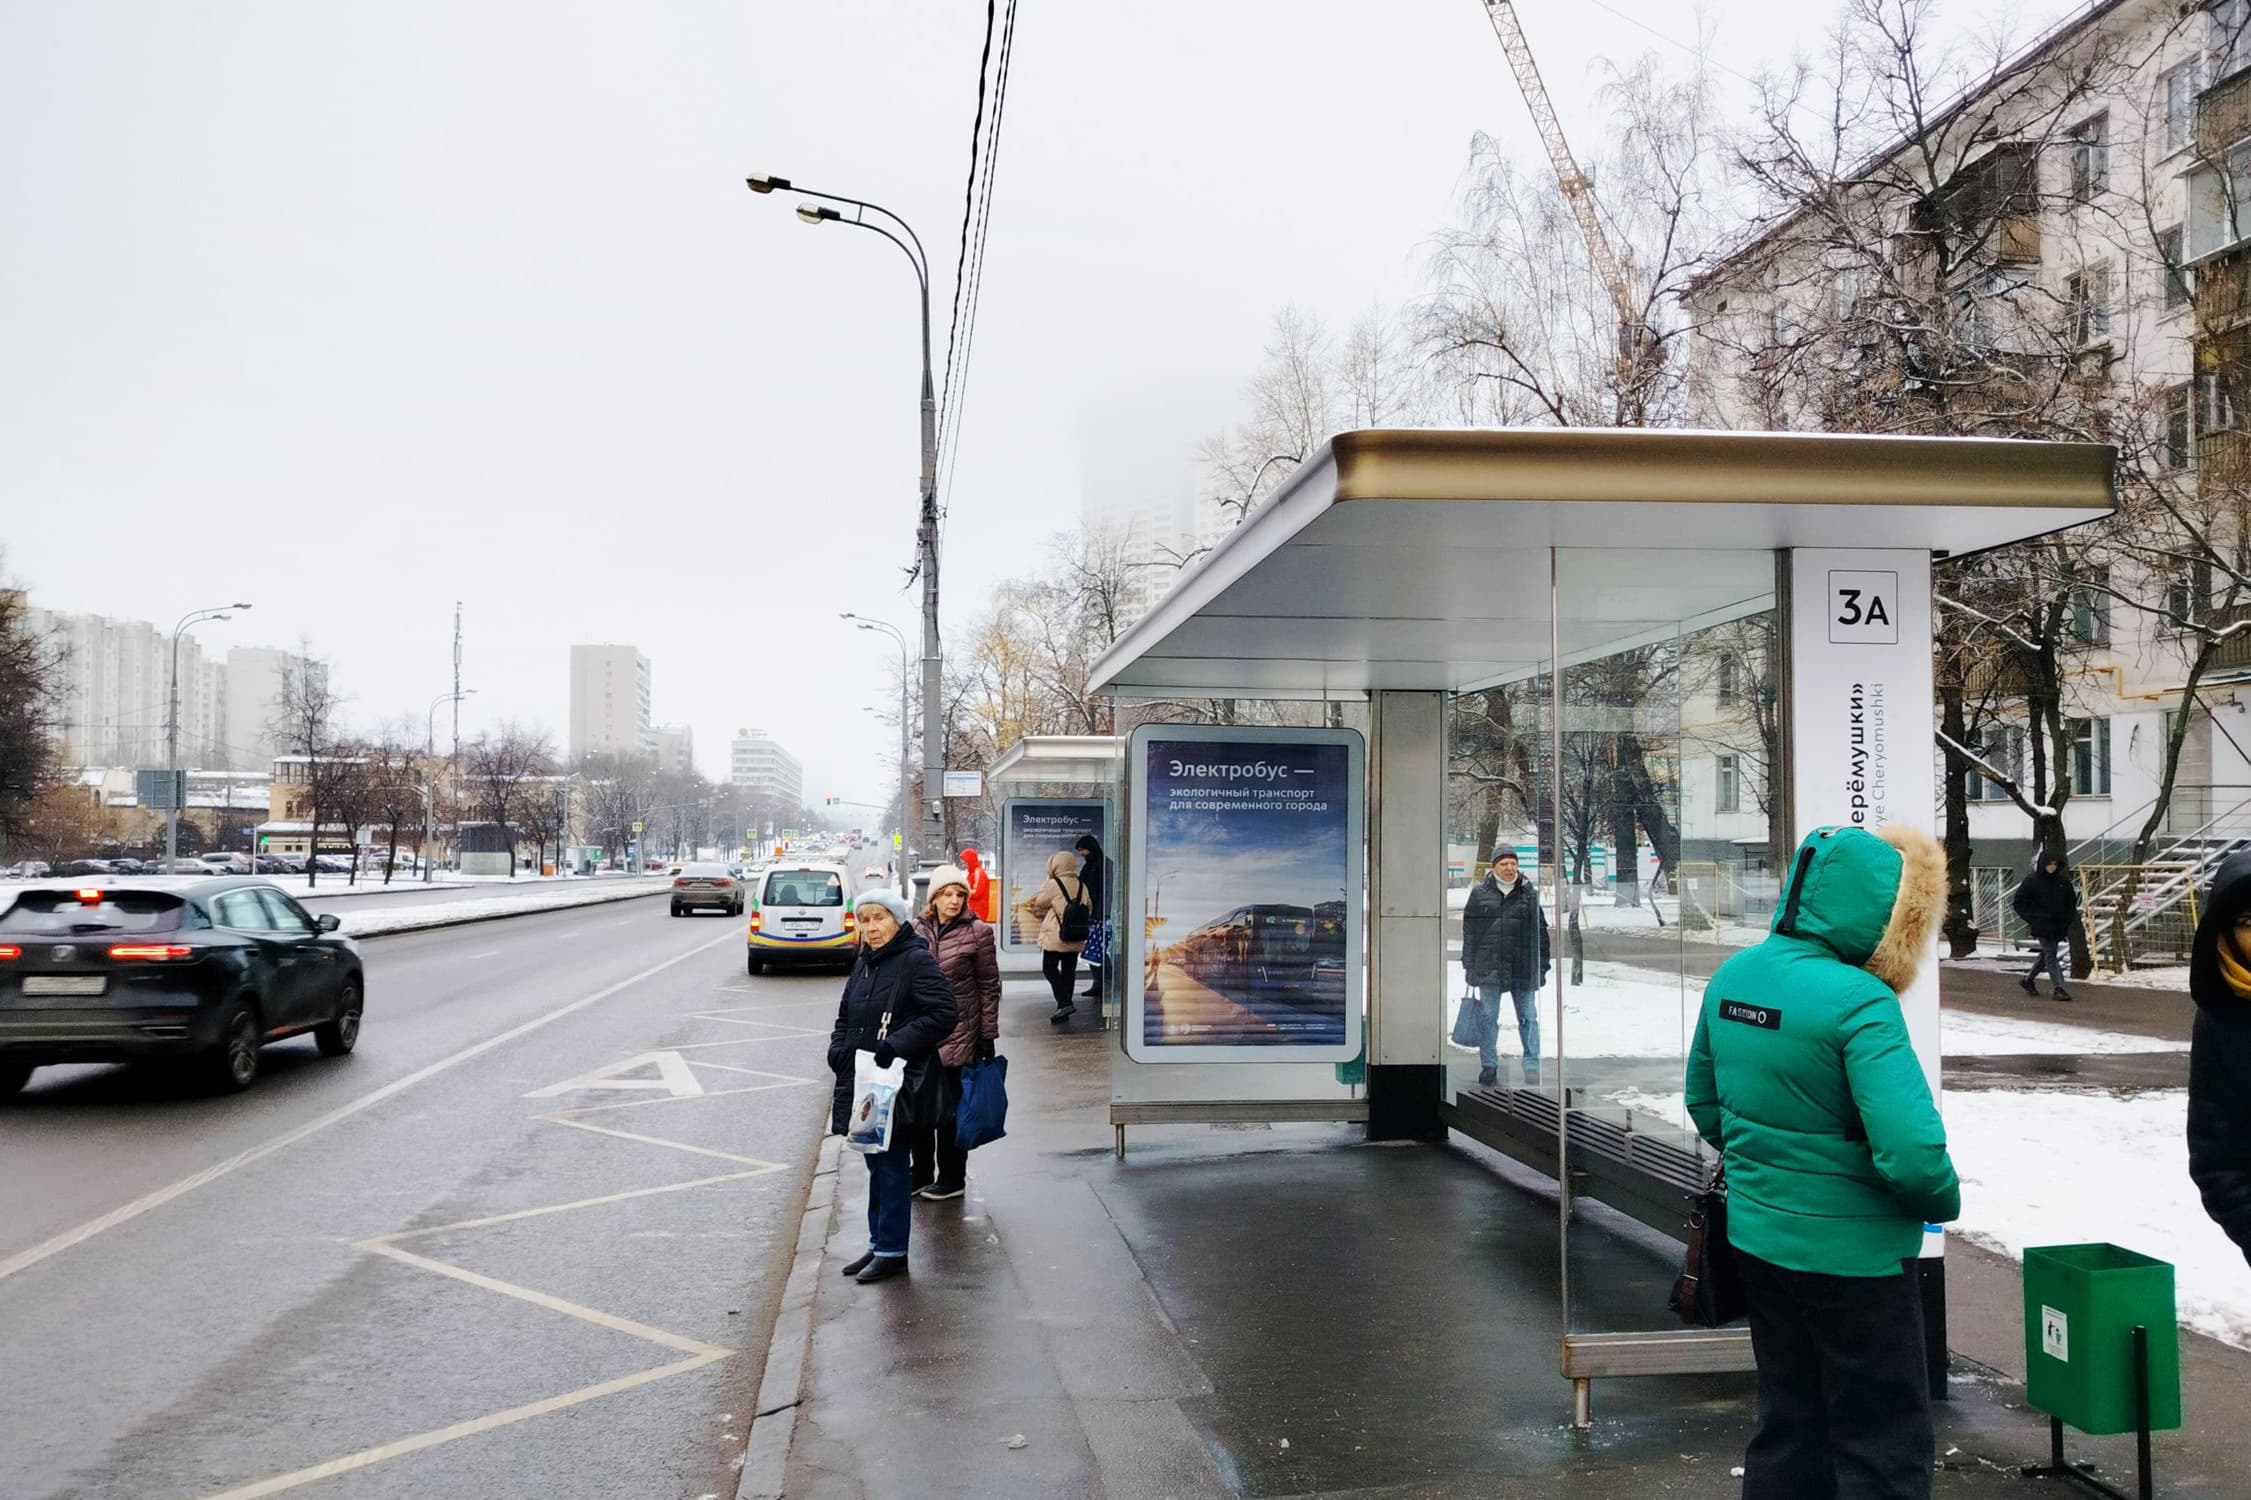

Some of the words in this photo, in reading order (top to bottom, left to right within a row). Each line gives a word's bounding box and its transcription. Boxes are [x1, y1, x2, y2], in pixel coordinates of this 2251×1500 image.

[1870, 683, 1887, 800] Cheryomushki
[1169, 760, 1288, 781] Электробус
[1169, 788, 1250, 798] экологичный
[1253, 789, 1315, 800] транспорт
[1169, 801, 1192, 811] для
[1195, 801, 1283, 811] современного
[1286, 802, 1328, 812] города
[1023, 814, 1079, 825] Электробус
